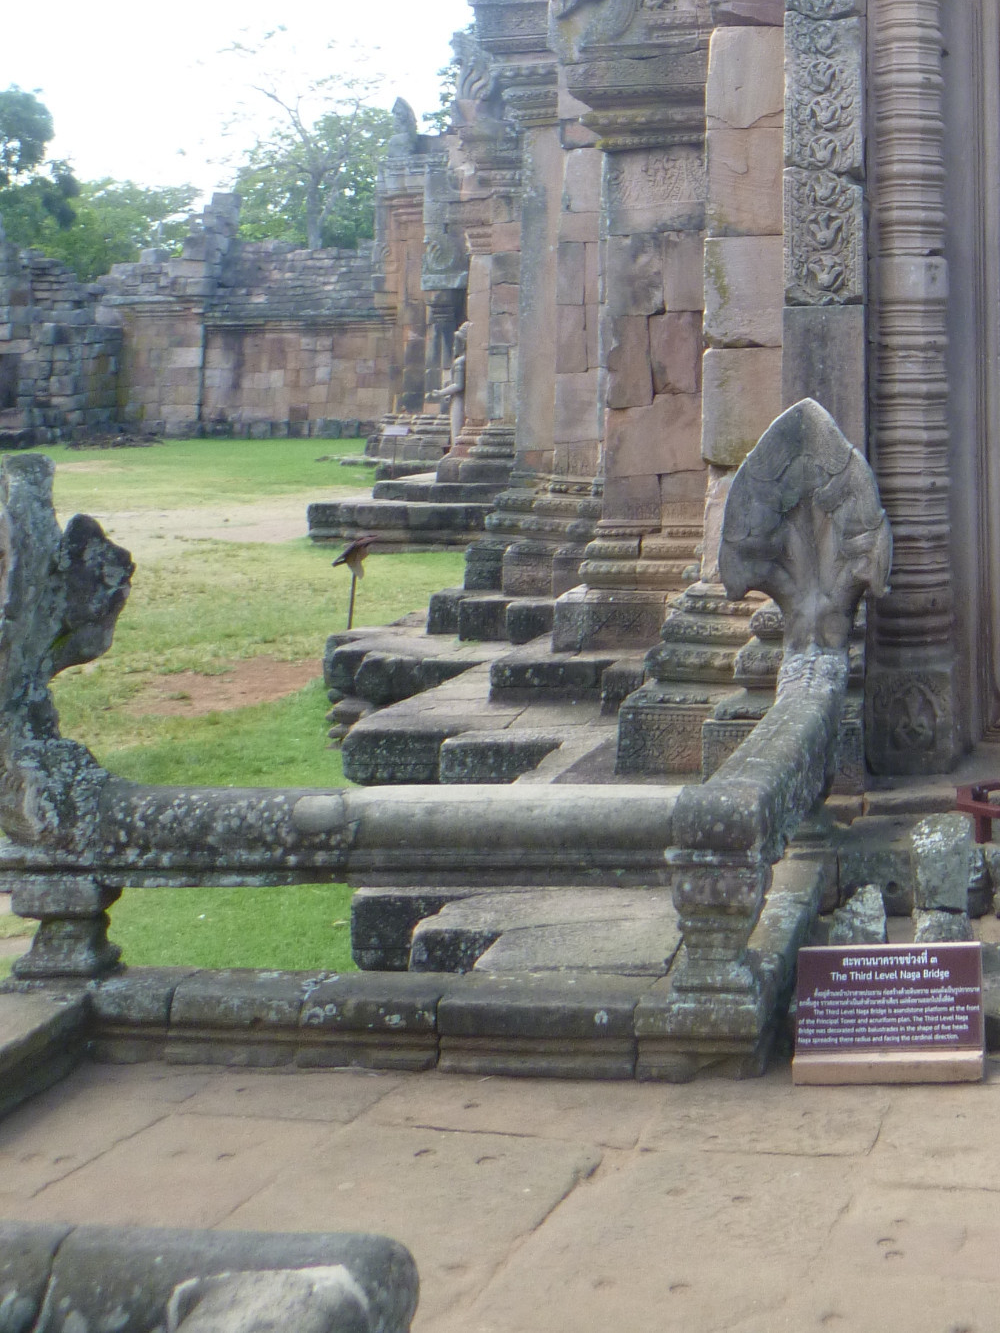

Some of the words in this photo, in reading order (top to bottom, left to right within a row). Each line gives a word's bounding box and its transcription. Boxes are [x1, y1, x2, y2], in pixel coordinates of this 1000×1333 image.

[831, 972, 847, 981] The
[851, 971, 872, 980] Third
[875, 970, 898, 980] Level
[900, 970, 920, 981] Naga
[924, 969, 949, 981] Bridge
